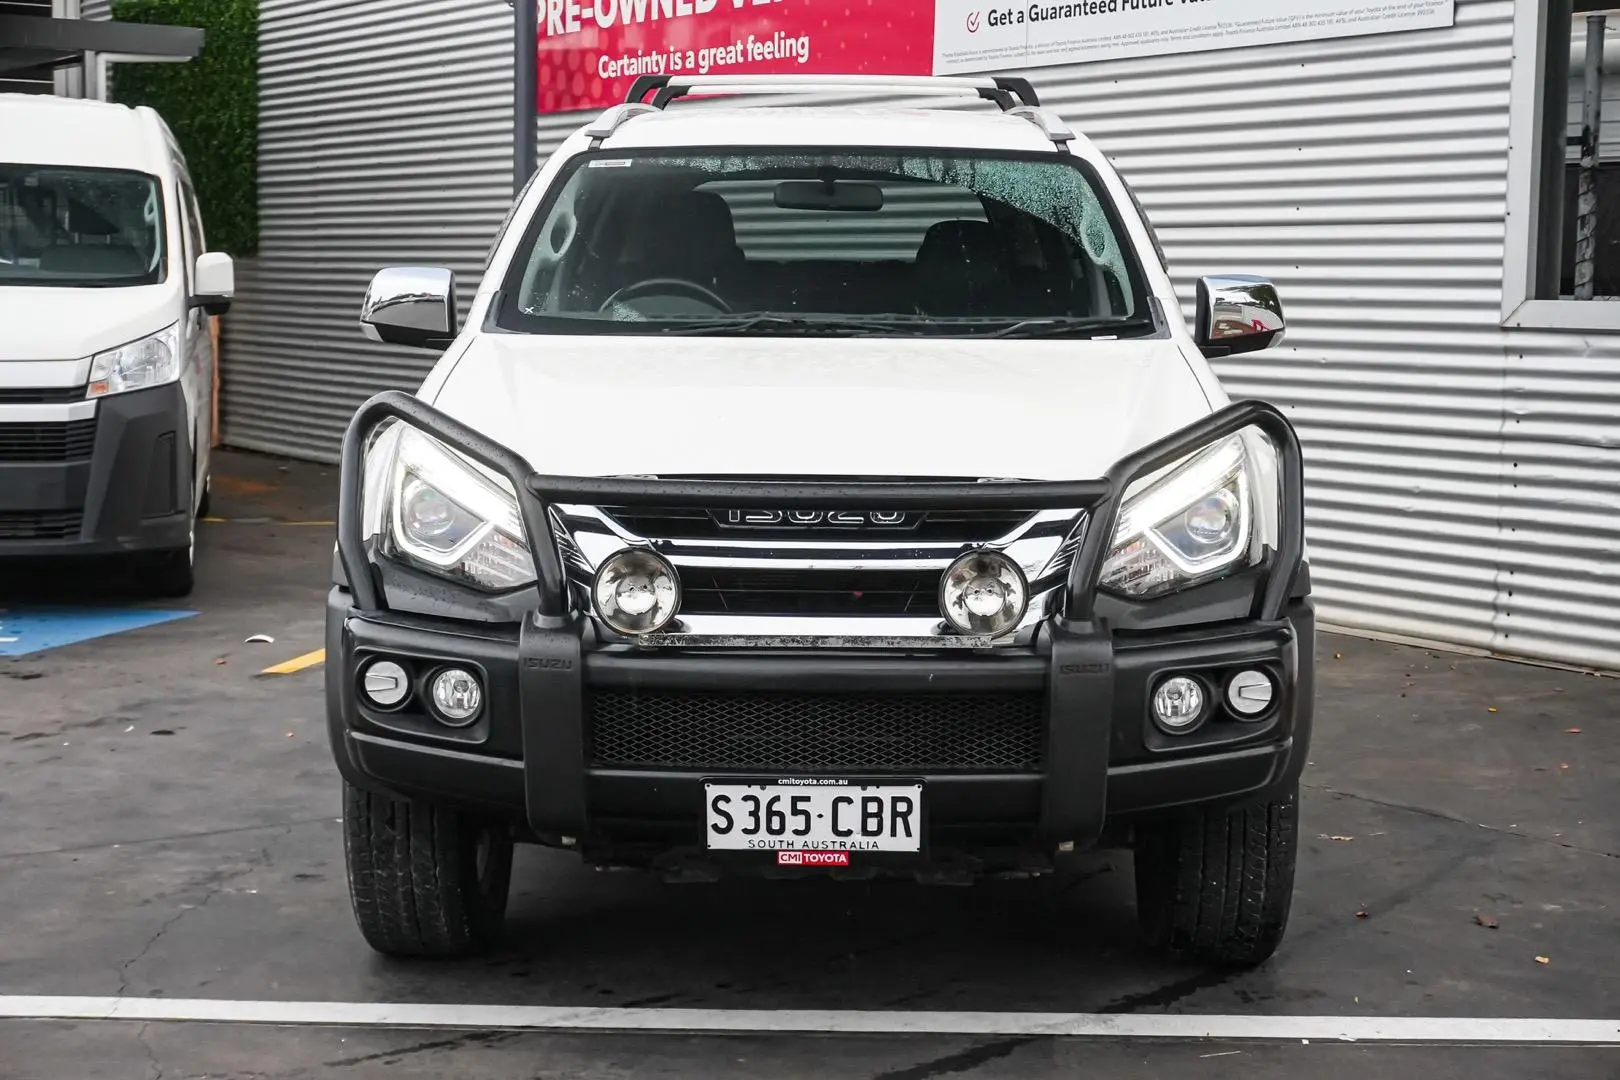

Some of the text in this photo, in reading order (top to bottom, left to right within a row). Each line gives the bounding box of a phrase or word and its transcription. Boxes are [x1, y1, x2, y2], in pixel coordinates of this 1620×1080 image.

[988, 8, 1013, 27] Get
[1016, 10, 1024, 24] a
[1028, 0, 1117, 22] Guaranteed
[598, 31, 809, 79] Certainty is a great feeling
[778, 777, 848, 786] cmitoyota.com.au
[748, 839, 880, 850] SOUTH AUSTRALIA
[803, 853, 847, 863] TOYOTA
